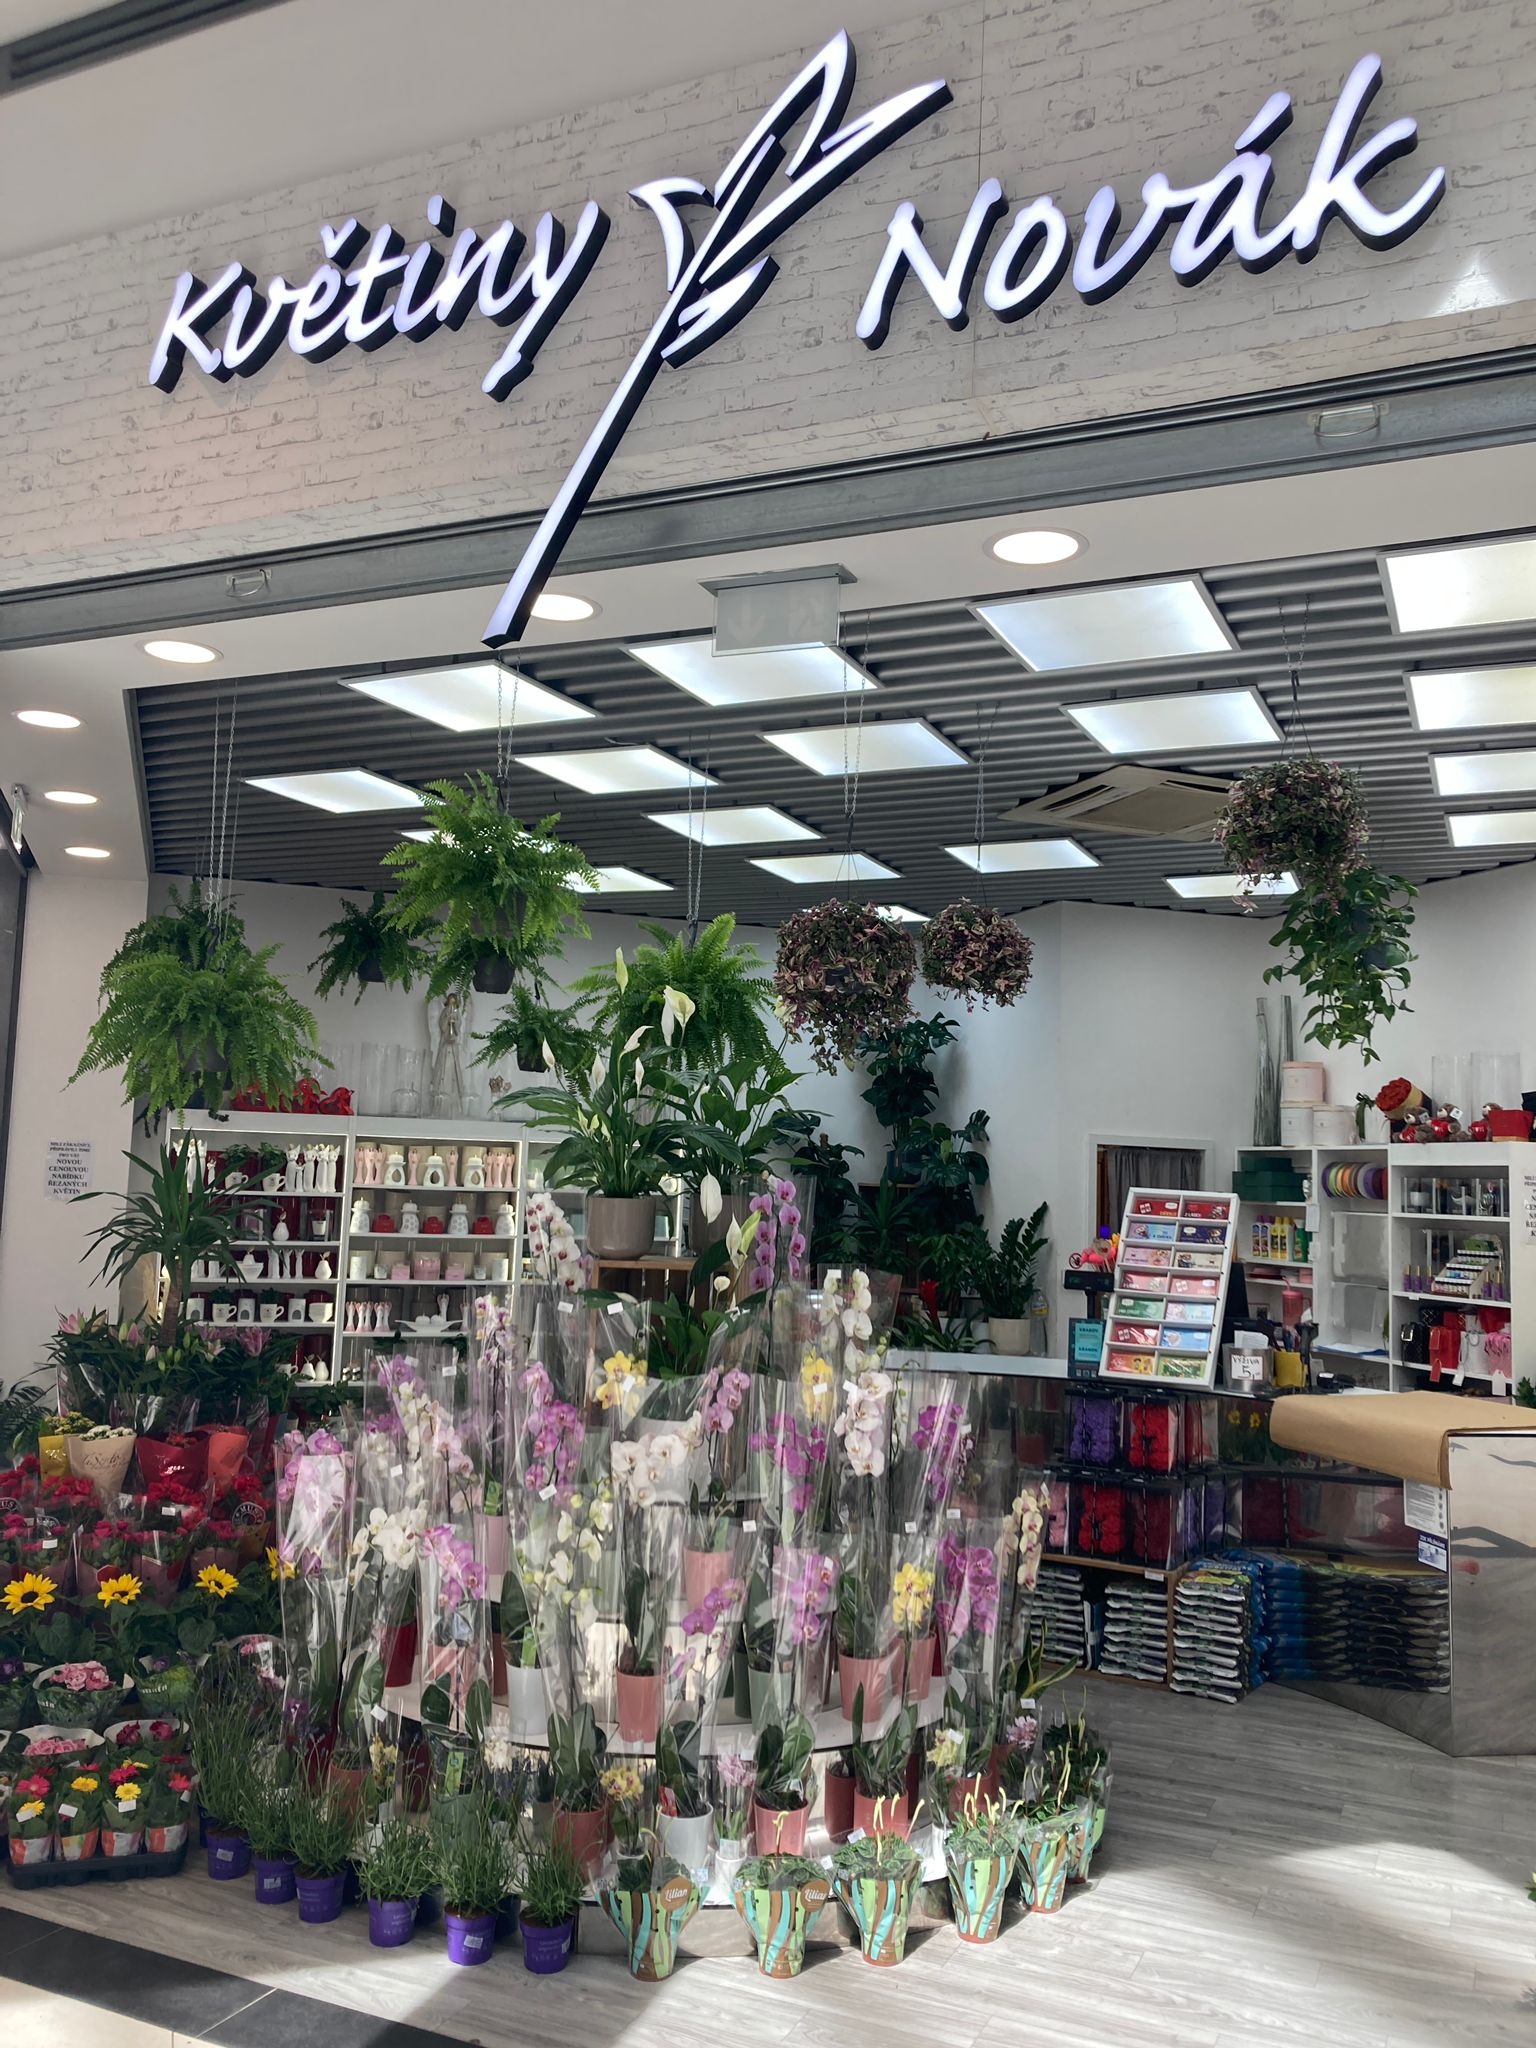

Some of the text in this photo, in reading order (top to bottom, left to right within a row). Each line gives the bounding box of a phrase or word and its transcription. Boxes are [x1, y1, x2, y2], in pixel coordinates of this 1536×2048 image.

[148, 52, 1446, 403] Květiny Novák
[664, 1887, 688, 1902] Lilian
